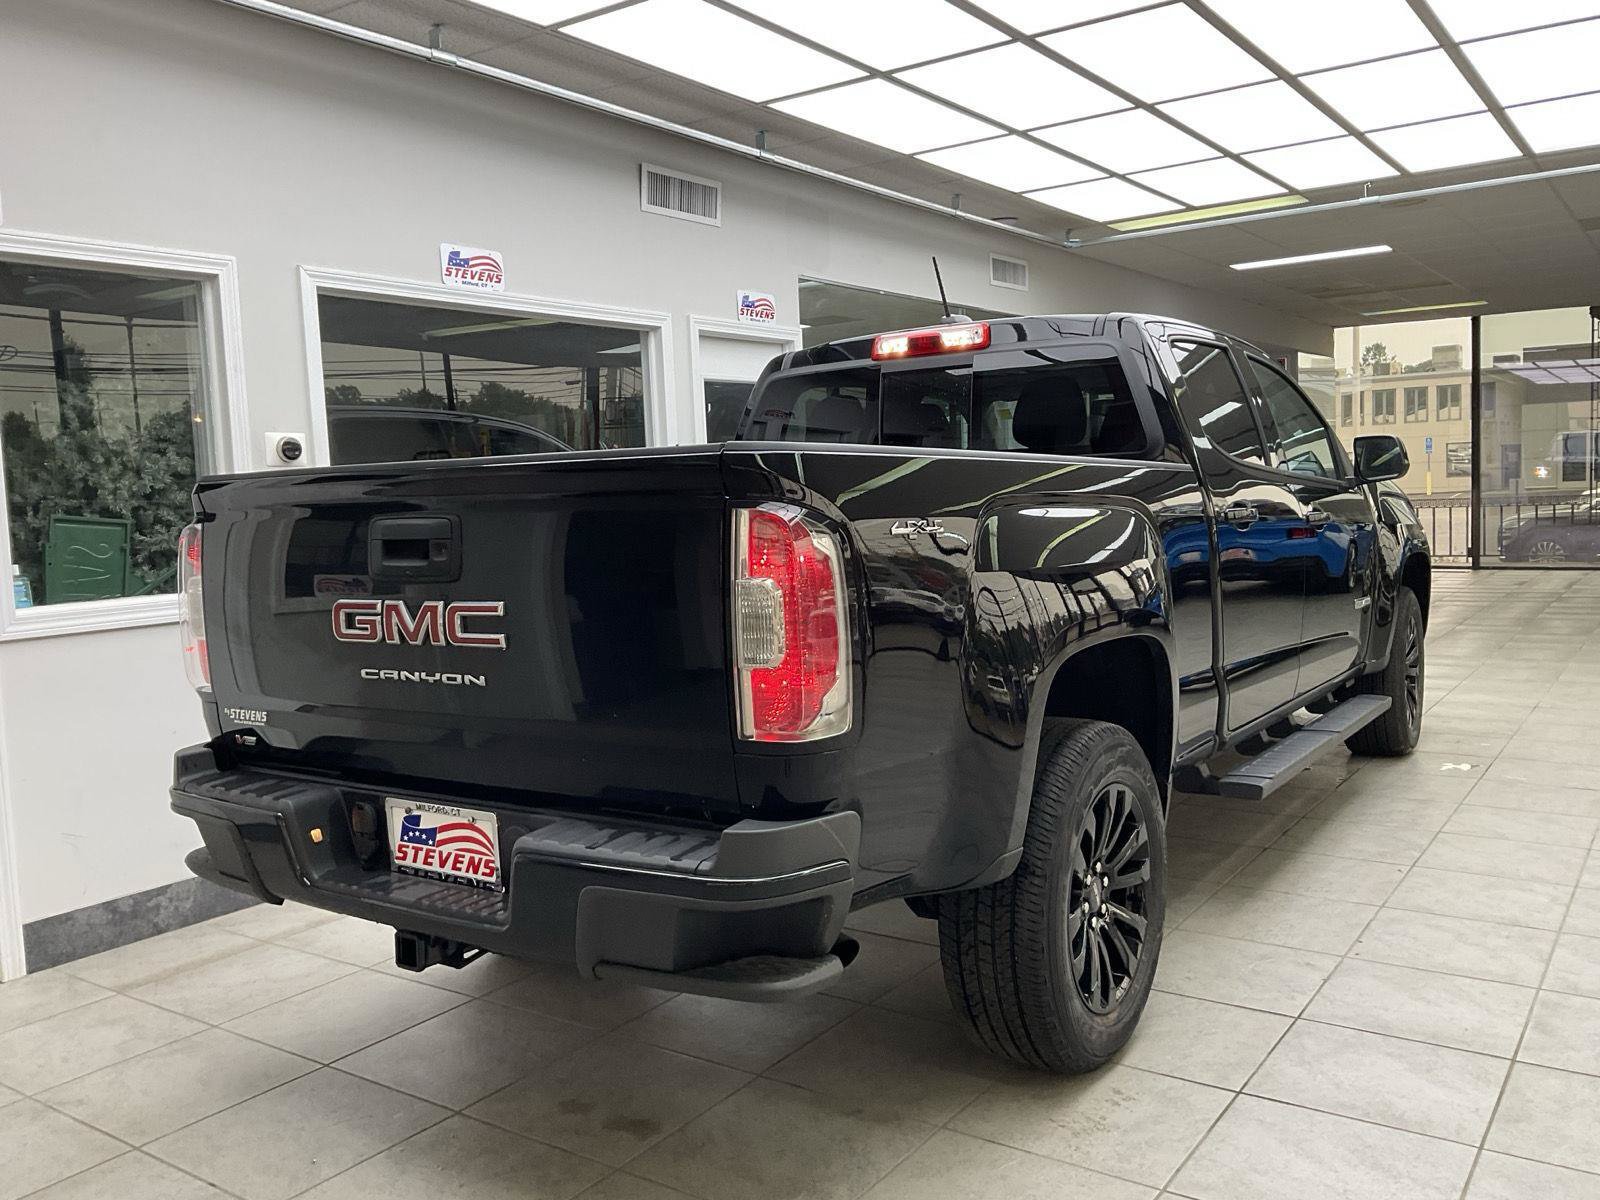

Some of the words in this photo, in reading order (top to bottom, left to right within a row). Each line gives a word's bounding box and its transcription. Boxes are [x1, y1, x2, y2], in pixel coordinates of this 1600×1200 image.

[444, 266, 503, 284] STEVENS
[740, 307, 776, 320] STEVENS
[331, 599, 507, 650] GMC
[360, 667, 486, 687] CANYON
[229, 708, 268, 722] STEVENS
[451, 808, 461, 817] CT
[395, 842, 497, 878] STEVENS
